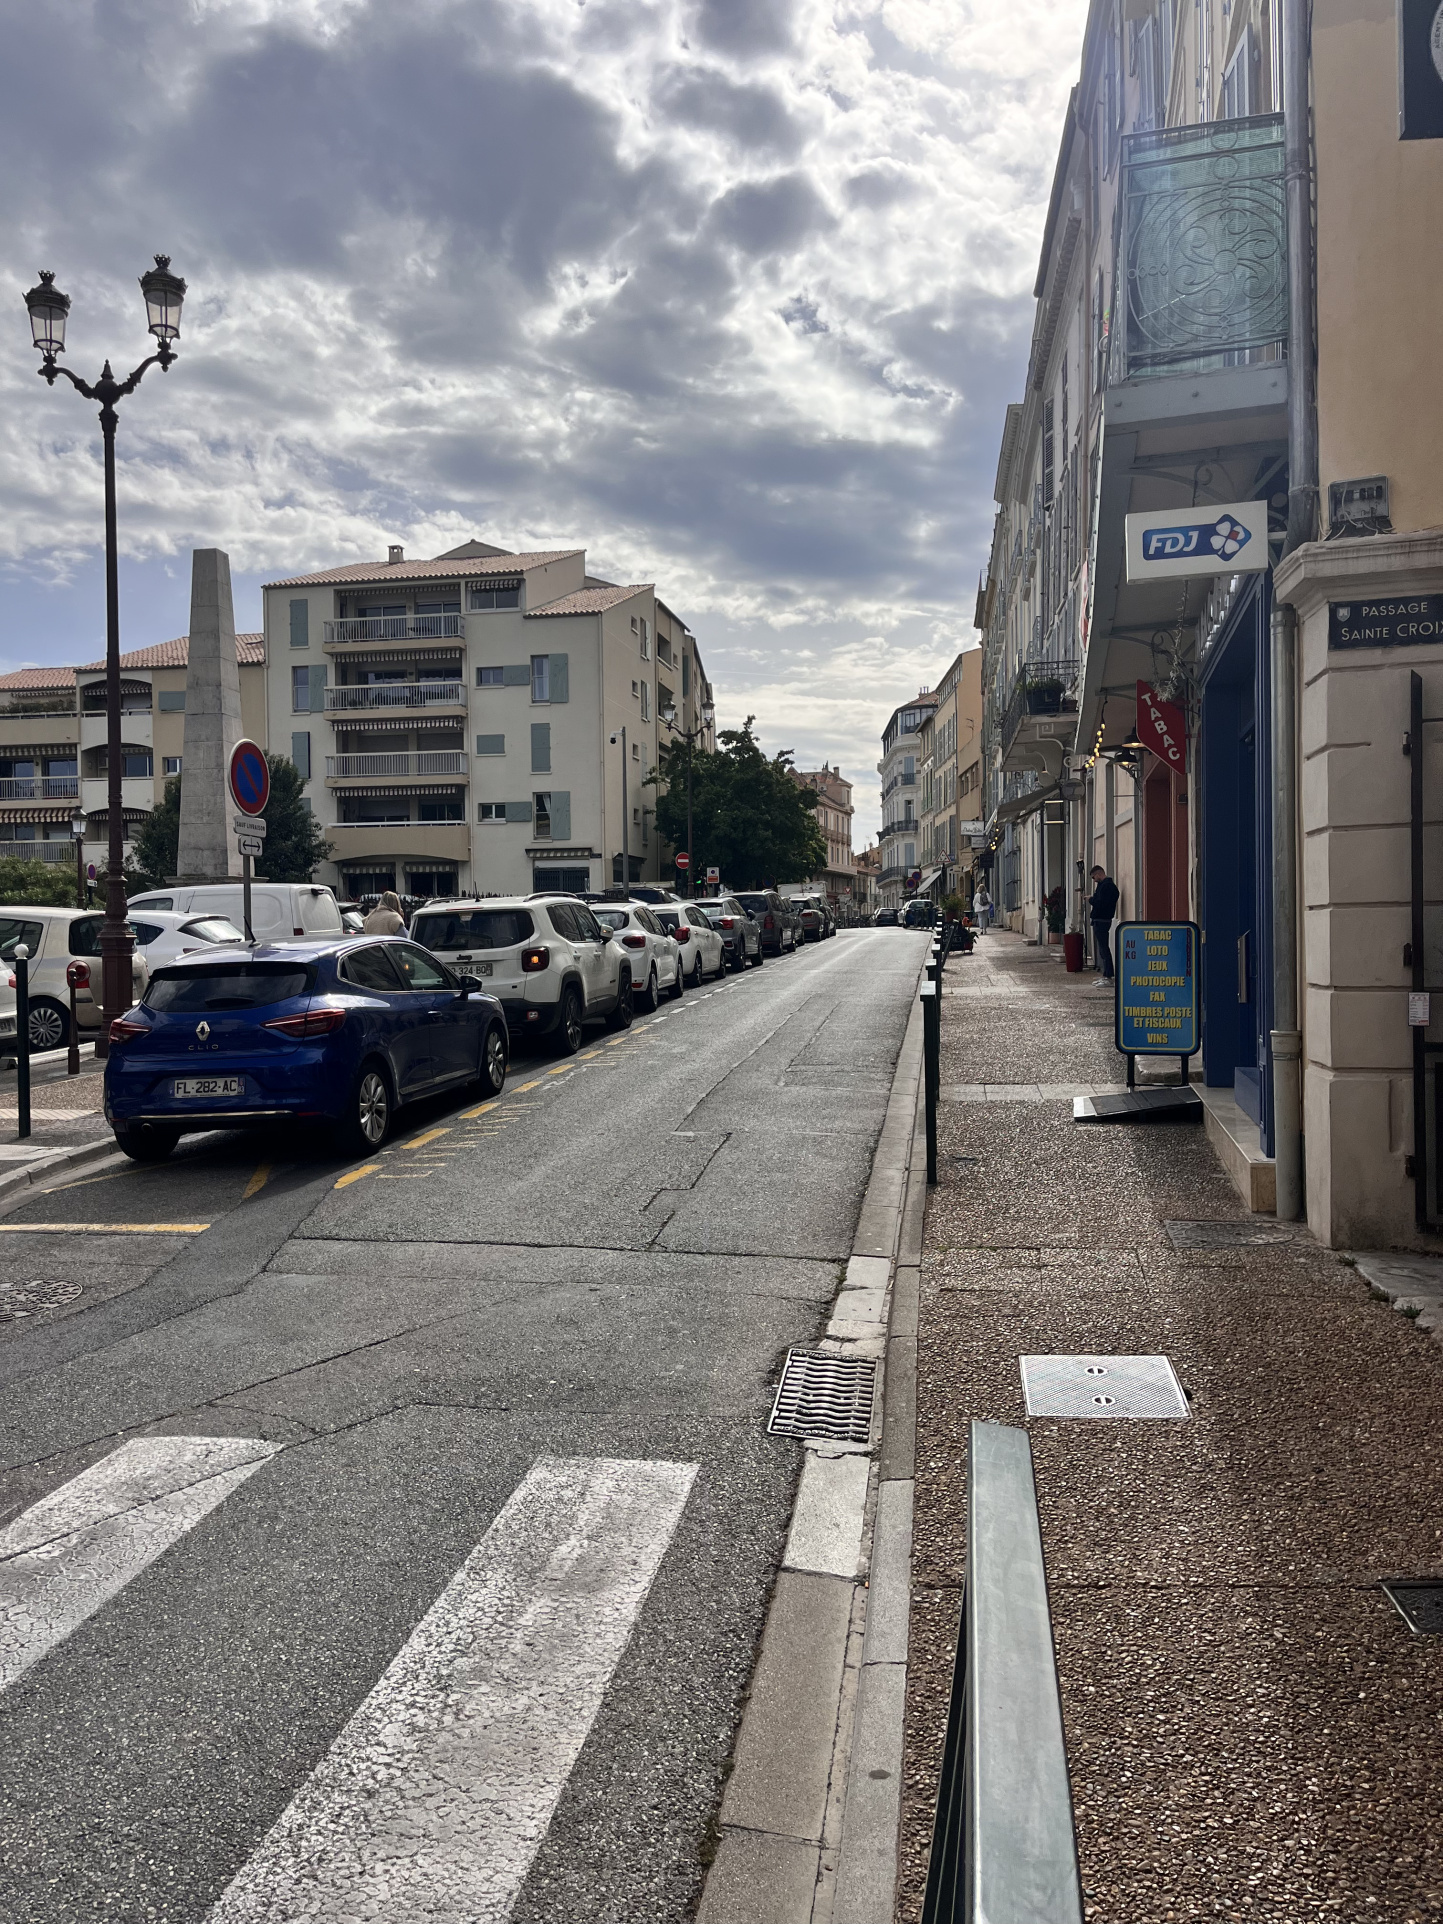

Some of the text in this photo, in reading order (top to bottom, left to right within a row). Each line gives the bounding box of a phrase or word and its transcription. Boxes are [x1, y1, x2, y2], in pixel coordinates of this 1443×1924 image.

[1148, 530, 1199, 555] FDJ
[1362, 602, 1428, 617] PASSAGE
[1341, 627, 1390, 641] SAINTE
[1141, 692, 1180, 760] TABAC
[1143, 930, 1172, 941] TABAC
[1125, 939, 1136, 949] AU
[1146, 945, 1168, 956] LOTO
[1148, 960, 1168, 971] JEUX
[1130, 976, 1186, 987] PHOTOCOPIE
[1149, 991, 1166, 1002] FAX
[1124, 1006, 1192, 1018] TIMBRES POSTE
[1133, 1017, 1182, 1029] ET FISCAUX
[1147, 1033, 1168, 1044] VINS
[176, 1080, 237, 1095] FL-282-AC
